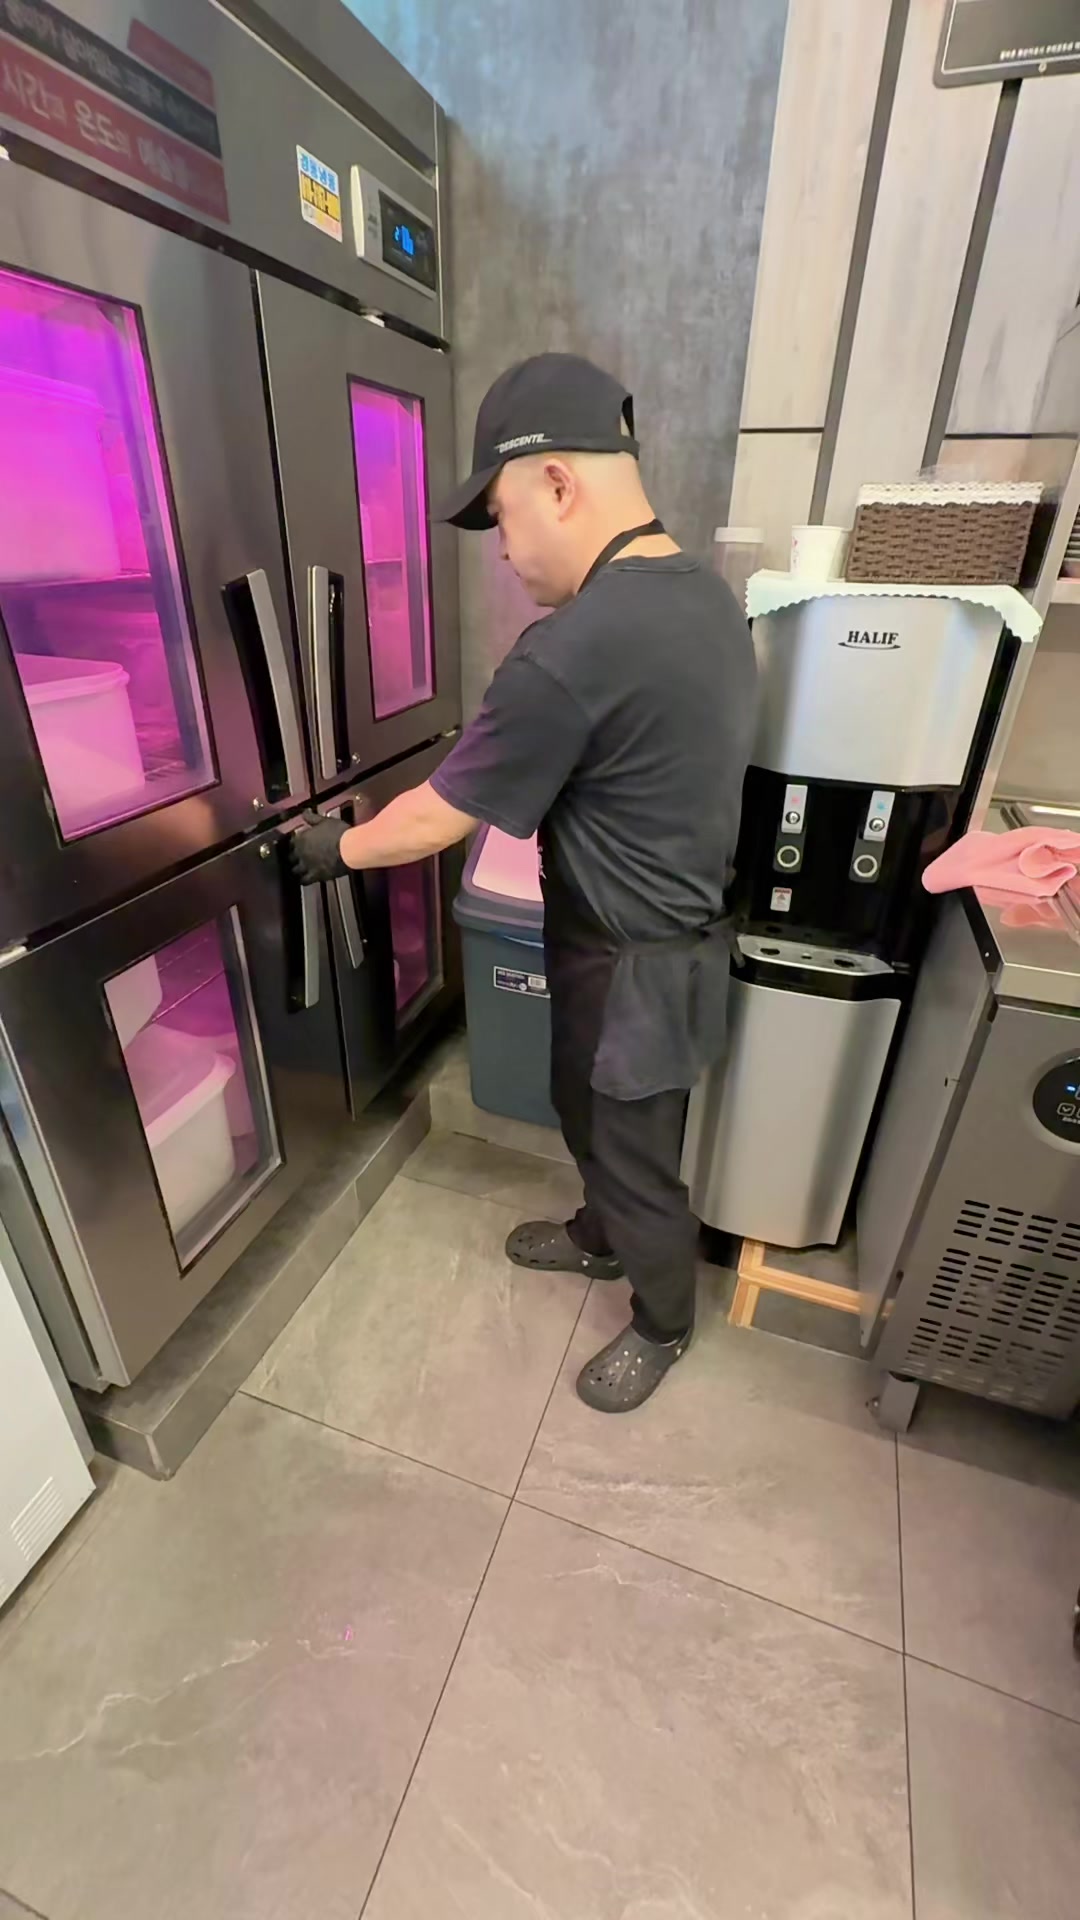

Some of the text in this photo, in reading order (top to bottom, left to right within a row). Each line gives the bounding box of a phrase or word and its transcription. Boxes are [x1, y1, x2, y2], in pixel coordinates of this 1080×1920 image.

[2, 58, 66, 127] 시간과
[74, 99, 130, 159] 온도의
[847, 630, 899, 645] HALIF
